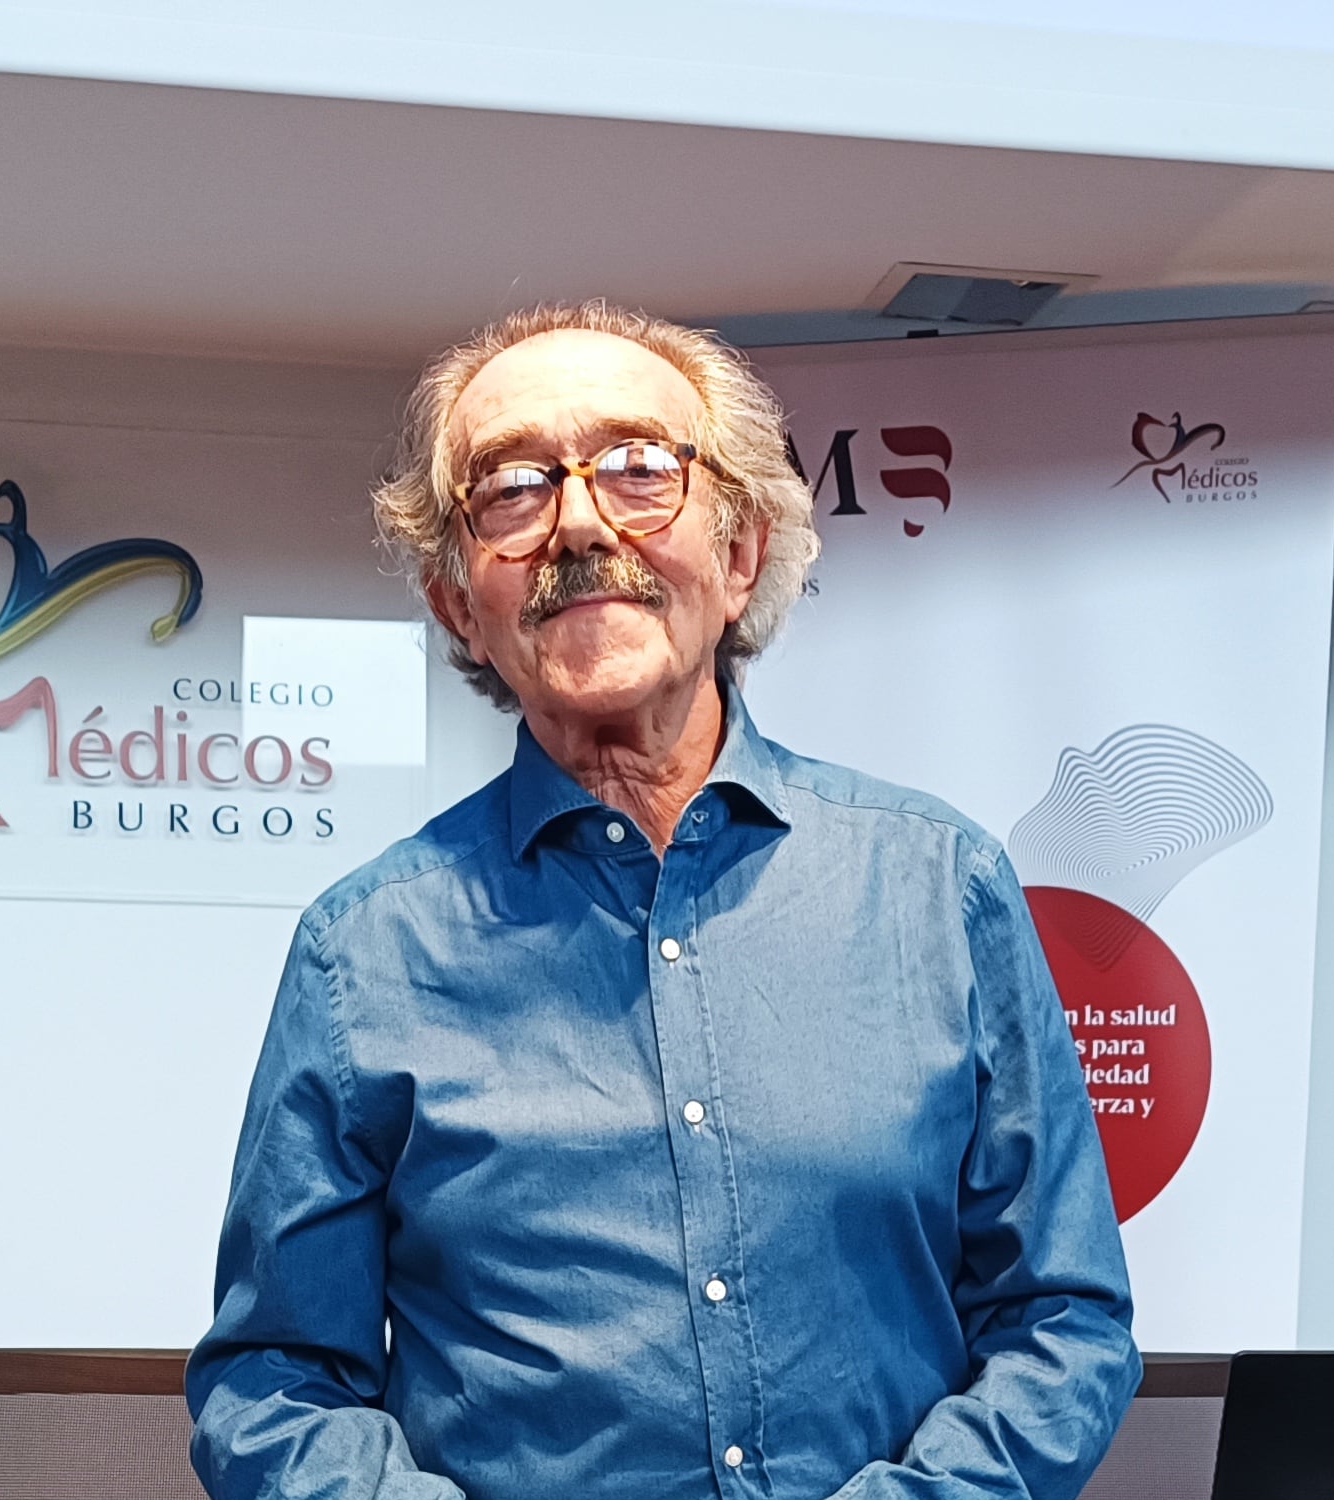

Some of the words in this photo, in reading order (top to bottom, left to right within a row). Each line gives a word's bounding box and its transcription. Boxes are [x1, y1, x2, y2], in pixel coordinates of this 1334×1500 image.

[1151, 462, 1259, 504] Médicos
[1185, 490, 1258, 503] BURGOS
[172, 677, 334, 708] COLEGIO
[71, 799, 335, 838] BURGOS
[1084, 1004, 1105, 1026] la
[1109, 1004, 1177, 1026] salud
[1091, 1039, 1146, 1060] para
[1084, 1063, 1150, 1085] iedad
[1089, 1096, 1135, 1114] erza
[1140, 1097, 1156, 1119] y
